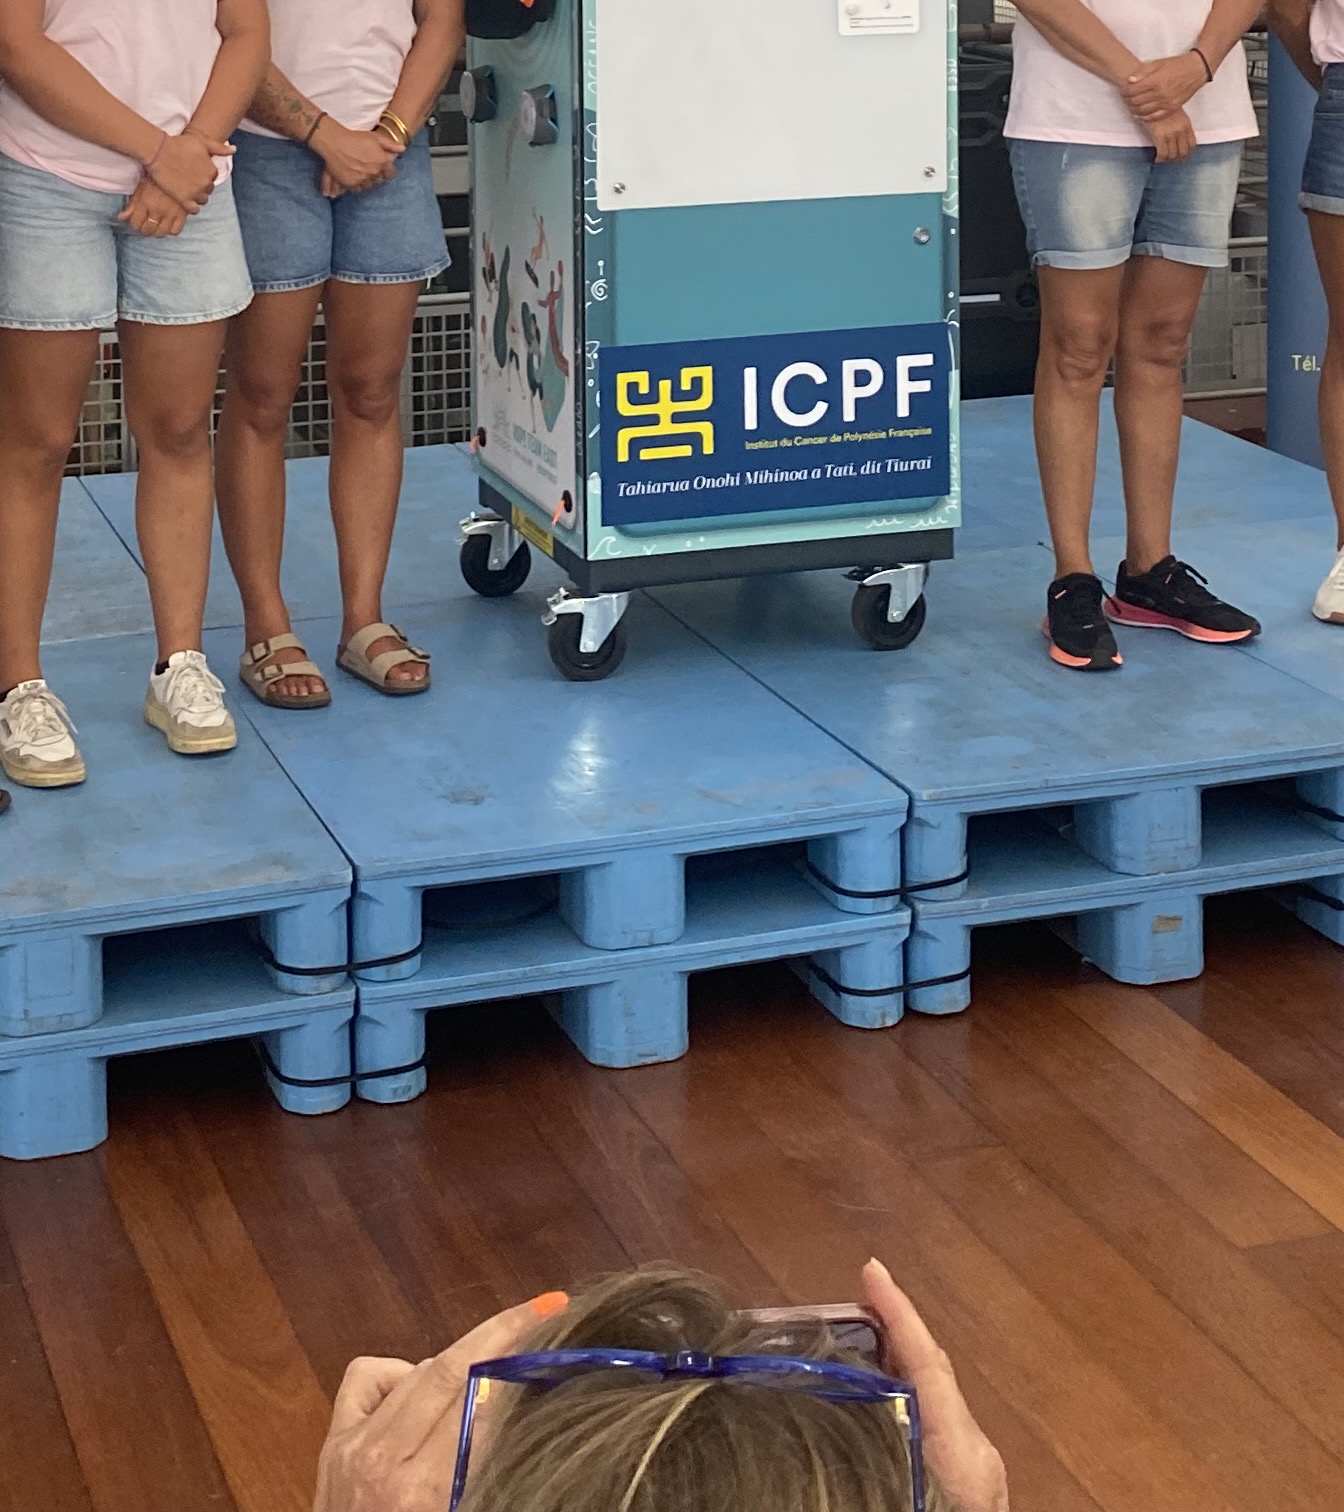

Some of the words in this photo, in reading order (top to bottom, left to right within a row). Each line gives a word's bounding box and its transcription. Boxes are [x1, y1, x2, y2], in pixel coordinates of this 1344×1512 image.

[1292, 354, 1321, 371] Tél.
[743, 353, 934, 430] ICPF
[745, 439, 778, 450] Institut
[780, 437, 792, 447] du
[794, 435, 827, 446] Cancer
[830, 433, 841, 443] de
[617, 478, 689, 497] Tahiarua
[693, 472, 740, 490] Onohi
[744, 467, 808, 486] Mihinoa
[811, 468, 822, 480] a
[860, 458, 882, 475] dit
[885, 455, 932, 474] Tiurai
